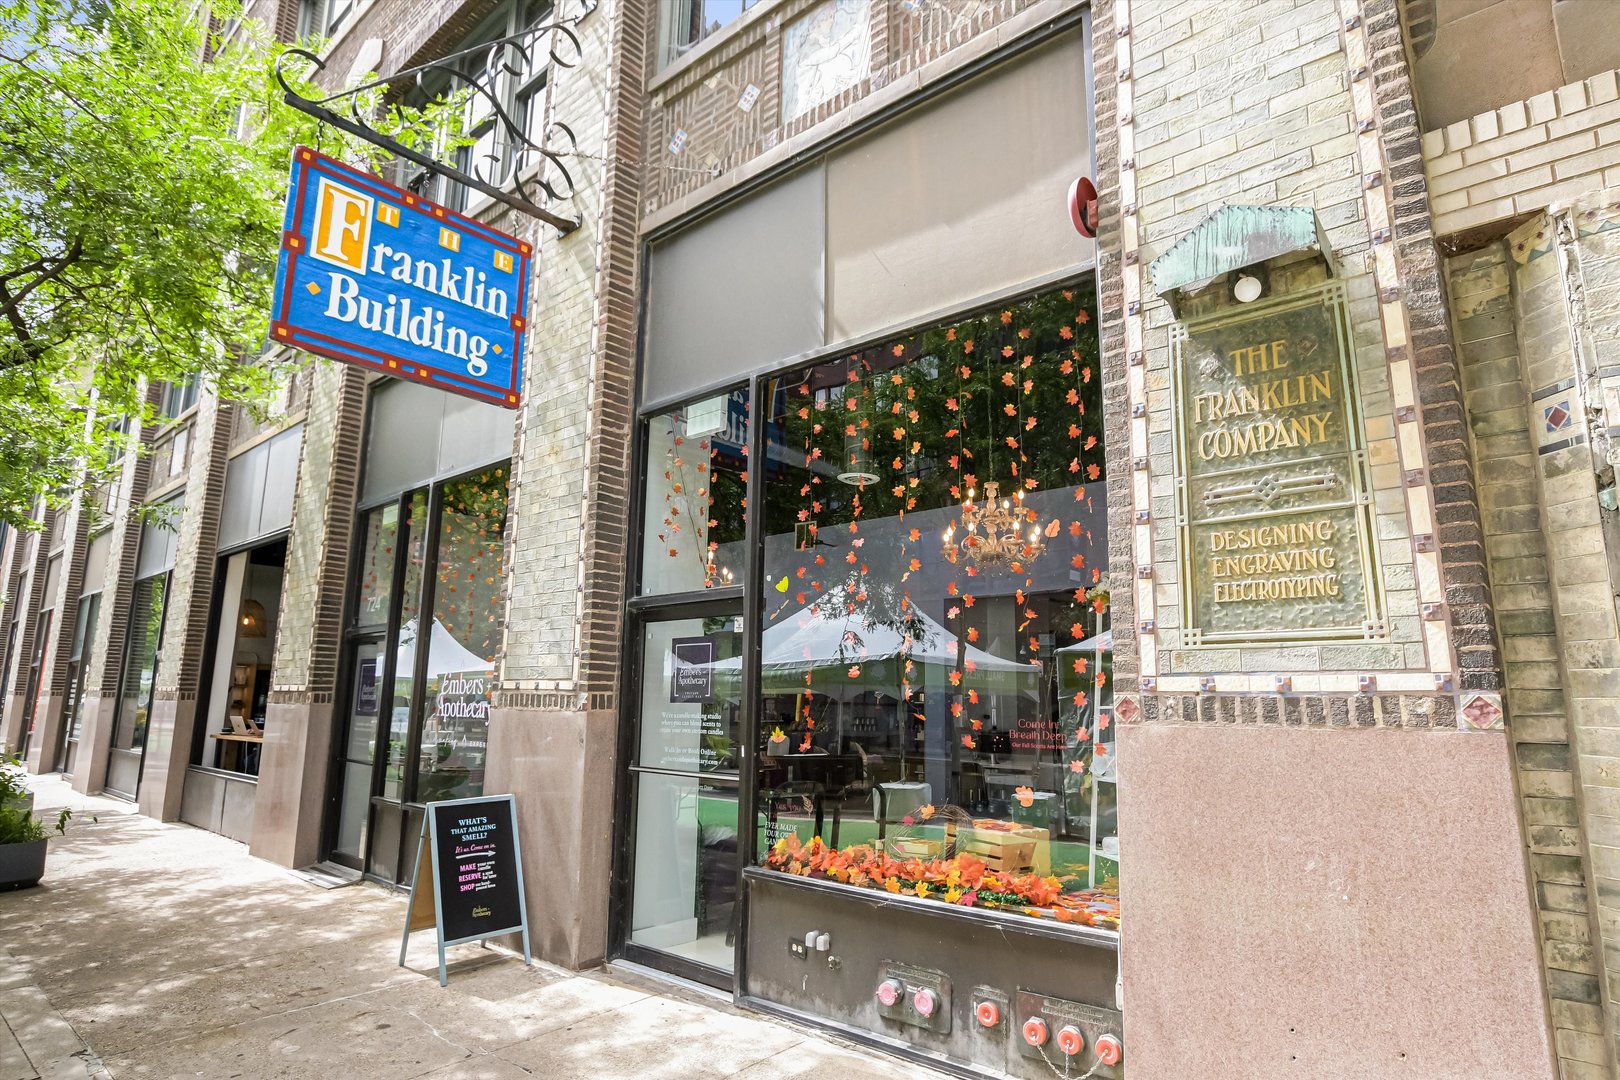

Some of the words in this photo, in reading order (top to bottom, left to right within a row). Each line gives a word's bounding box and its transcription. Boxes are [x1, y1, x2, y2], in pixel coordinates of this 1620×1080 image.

[320, 187, 508, 320] Franklin
[324, 272, 490, 377] Building
[1229, 340, 1289, 377] THE
[1194, 370, 1332, 423] FRANKLIN
[1199, 411, 1333, 461] COMPANY
[1210, 519, 1334, 552] DESIGNING
[1212, 547, 1336, 578] ENGRAVING
[1214, 575, 1340, 603] ELECTROTYPING
[441, 672, 484, 695] Embers
[678, 676, 708, 687] Apothecary
[436, 695, 491, 727] Apothecary
[1018, 718, 1046, 729] Come
[1009, 729, 1040, 740] Breath
[1042, 730, 1068, 744] Deep
[458, 816, 488, 826] WHAT'S
[468, 824, 496, 832] AMAZING
[780, 824, 798, 832] MADE
[462, 832, 488, 842] SMELL?
[458, 872, 482, 882] RESERVE
[460, 863, 476, 872] MAKE
[460, 883, 476, 892] SHOP
